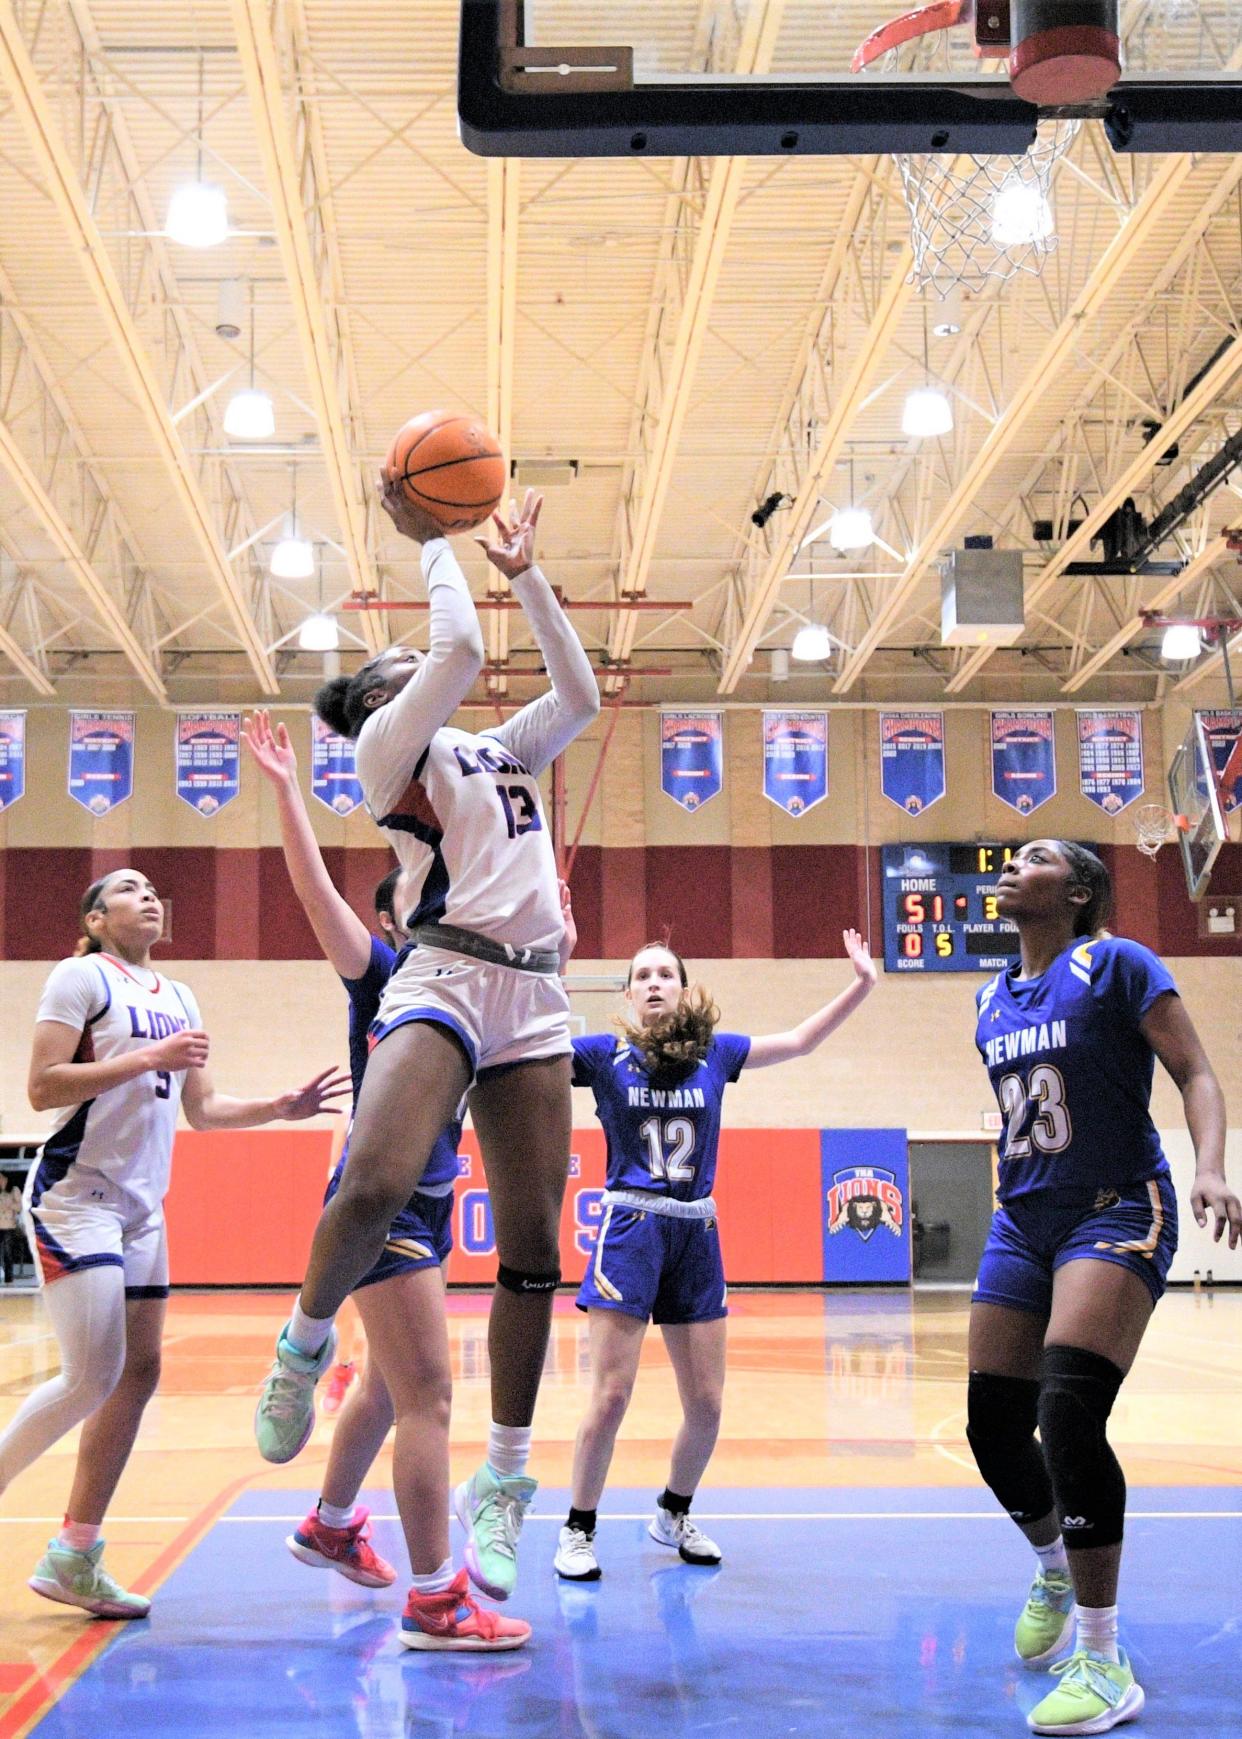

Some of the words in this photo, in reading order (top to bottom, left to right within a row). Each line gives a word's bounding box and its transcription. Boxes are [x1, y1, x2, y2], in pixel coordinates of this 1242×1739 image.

[496, 785, 542, 839] 13
[901, 879, 936, 891] HOME
[905, 894, 943, 924] 51
[985, 896, 999, 920] 3
[896, 924, 923, 933] FOULS
[963, 923, 994, 933] PLAYER
[936, 933, 952, 957] 5
[897, 959, 924, 968] SCORE
[979, 958, 1008, 967] MATCH
[985, 1020, 1067, 1068] NEWMAN
[628, 1086, 705, 1108] NEWMAN
[1000, 1064, 1072, 1160] 23
[640, 1116, 696, 1181] 12
[827, 1178, 903, 1227] LIONS
